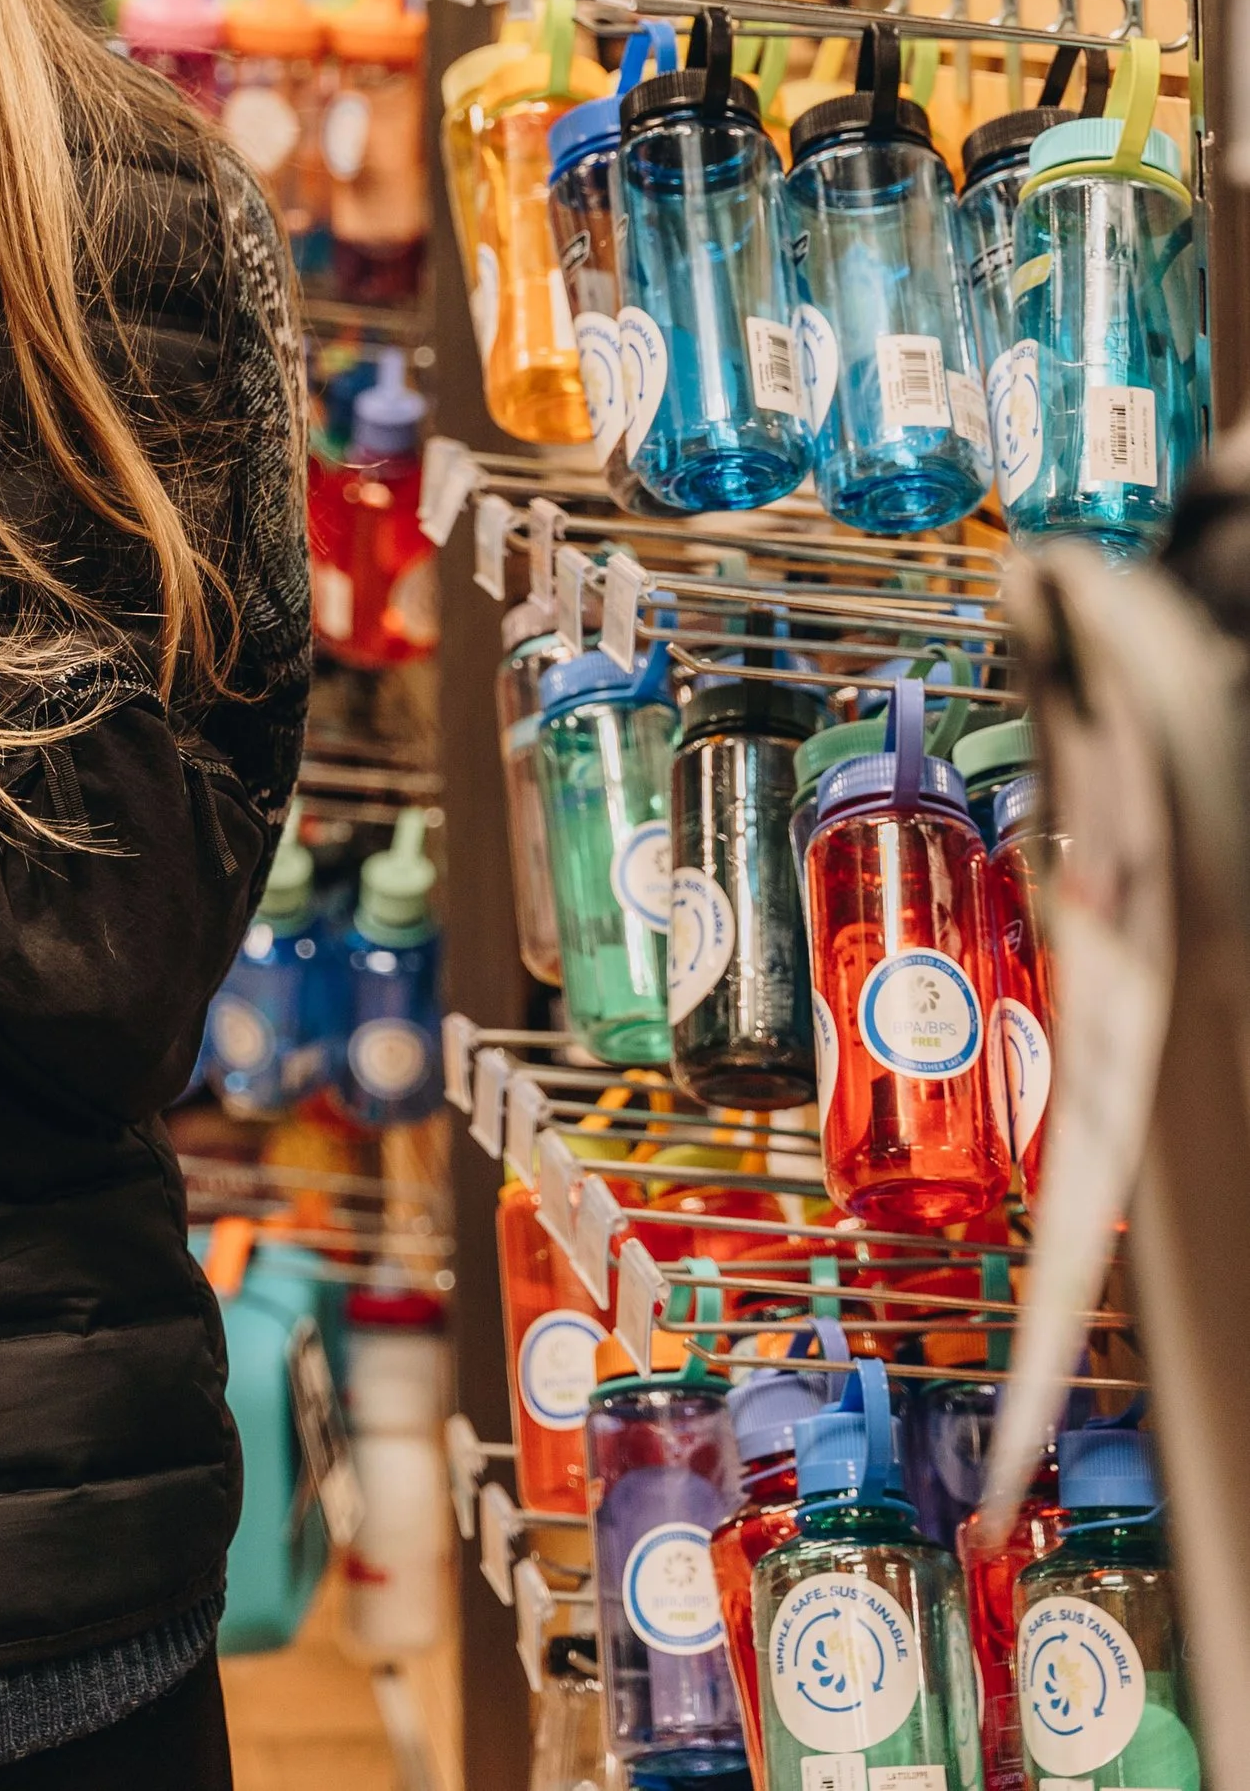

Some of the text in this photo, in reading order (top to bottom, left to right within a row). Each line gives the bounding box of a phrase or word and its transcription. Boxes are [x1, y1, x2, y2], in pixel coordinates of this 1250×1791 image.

[893, 1021, 957, 1036] BPA/BPS
[911, 1037, 942, 1048] FREE
[777, 1619, 794, 1675] SIMPLE.
[791, 1588, 826, 1616] SAFE.
[830, 1585, 908, 1663] SUSTAINABLE.
[1028, 1611, 1057, 1636] SAFE.
[1059, 1609, 1132, 1689] SUSTAINABLE.
